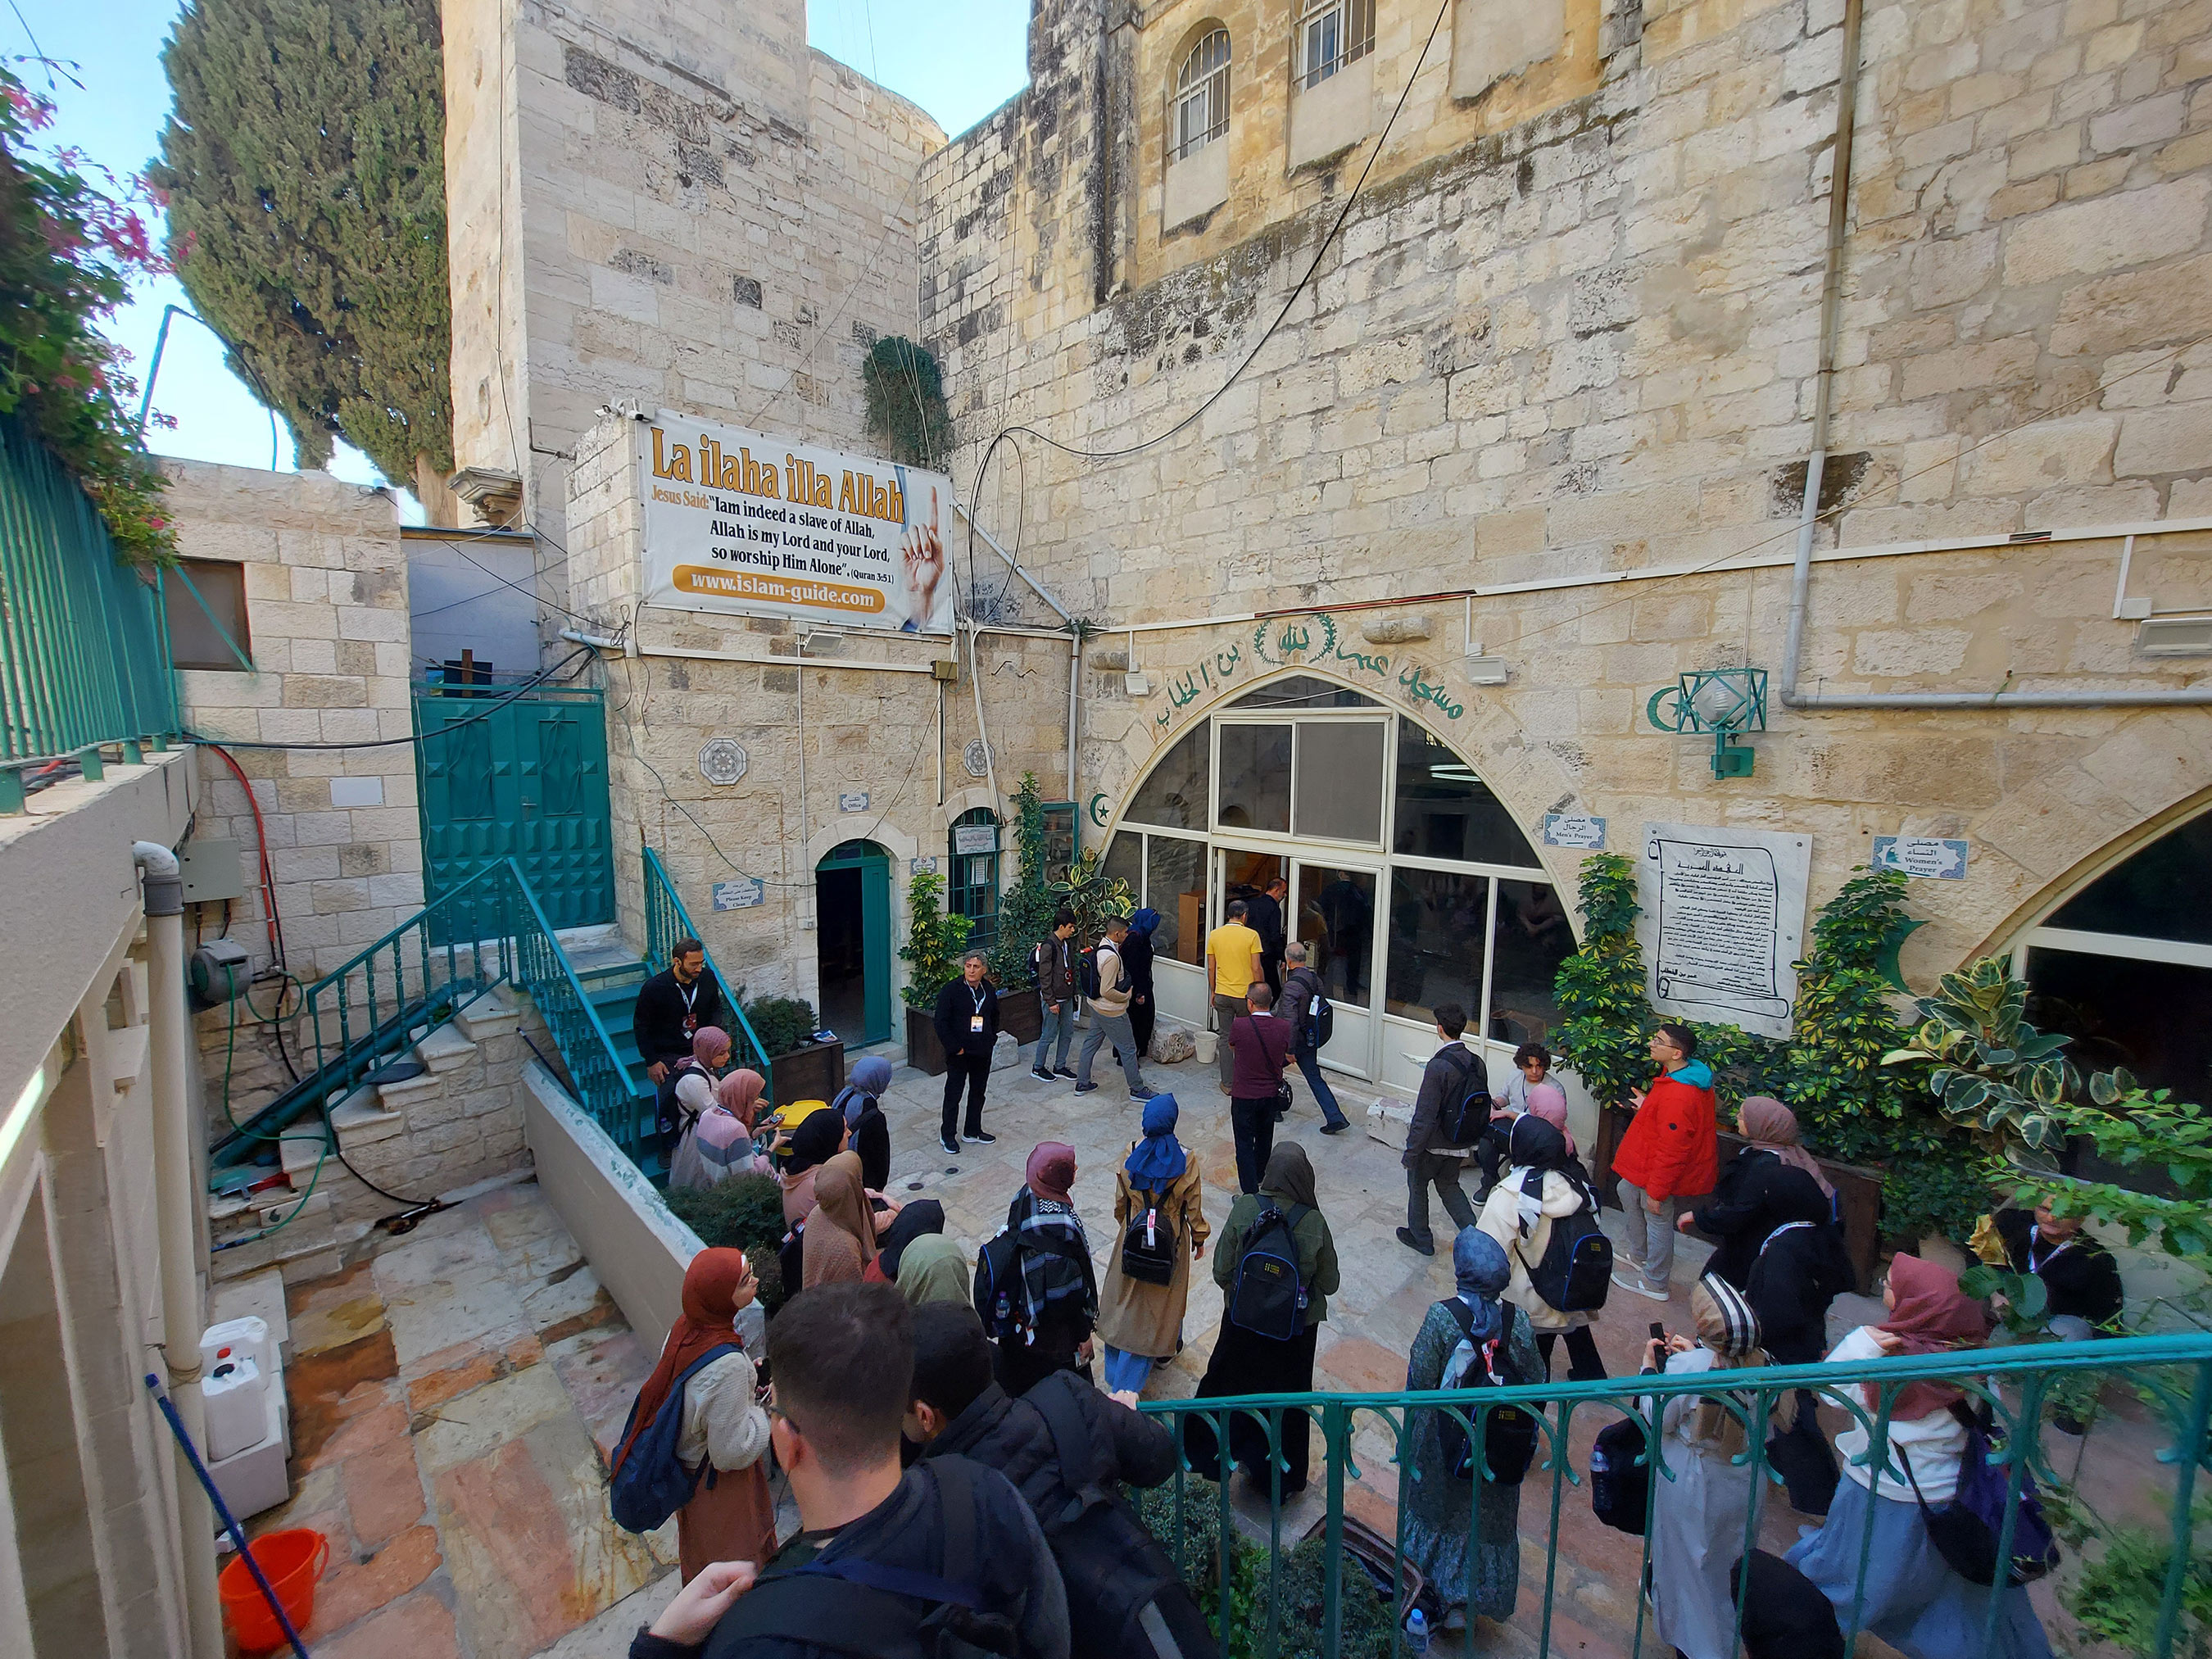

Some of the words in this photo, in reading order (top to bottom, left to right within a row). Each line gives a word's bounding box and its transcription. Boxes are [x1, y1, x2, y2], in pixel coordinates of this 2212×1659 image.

[650, 427, 694, 483] La
[699, 434, 781, 500] ilaha
[786, 453, 833, 510] illa
[838, 469, 904, 524] Allah
[651, 485, 682, 505] Jesus
[683, 491, 709, 510] Said:
[743, 501, 786, 523] indeed
[789, 512, 796, 524] a
[799, 512, 827, 530] slave
[830, 518, 842, 533] of
[845, 519, 875, 539] Allah,
[710, 520, 745, 539] Allah
[748, 524, 759, 541] is
[761, 530, 780, 548] my
[782, 531, 810, 550] Lord
[813, 538, 834, 553] and
[836, 542, 861, 558] your
[863, 545, 890, 563] Lord,
[712, 547, 728, 560] so
[730, 550, 780, 571] worship
[782, 554, 807, 571] Him
[850, 569, 876, 581] (Quran
[691, 573, 874, 606] www.islam-guide.com
[1217, 644, 1241, 677] بن
[1336, 641, 1389, 676] عمر
[1156, 661, 1210, 727] الخطاب
[1398, 665, 1464, 719] مسجد
[1562, 823, 1586, 832] الرجال
[1575, 832, 1593, 841] Prayer
[1909, 865, 1937, 873] Prayer
